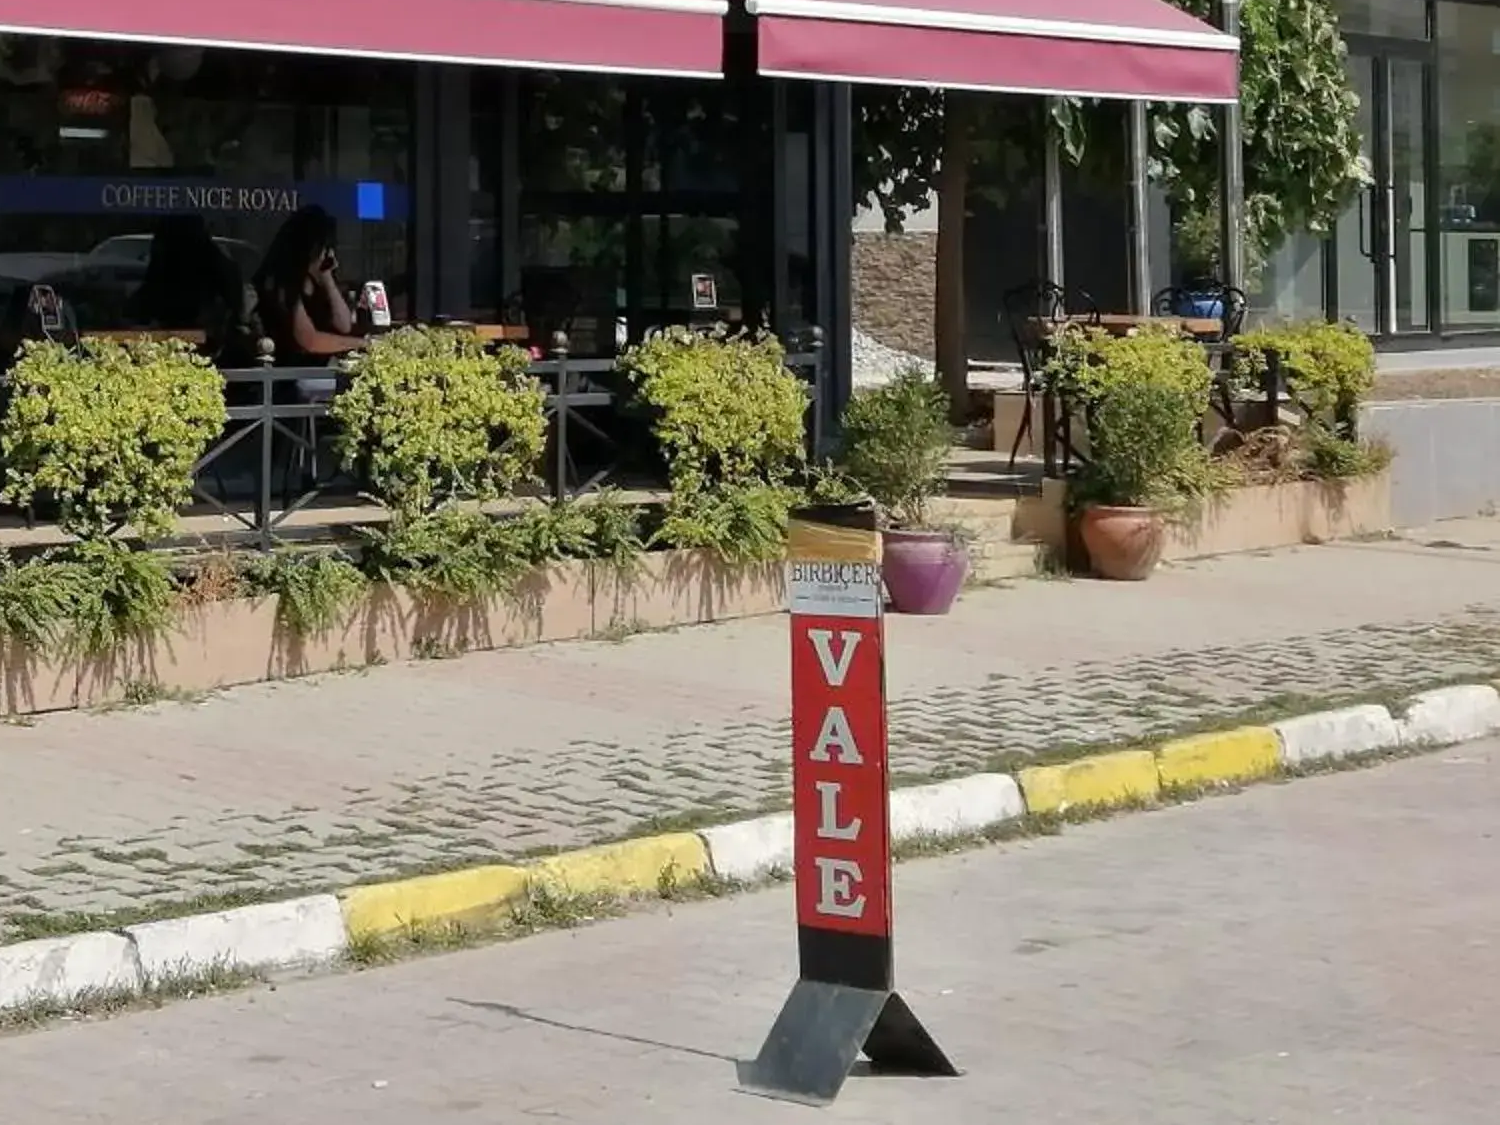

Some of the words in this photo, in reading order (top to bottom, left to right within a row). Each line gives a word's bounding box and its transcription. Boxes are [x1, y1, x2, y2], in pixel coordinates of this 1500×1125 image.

[101, 183, 180, 210] COFFEE
[186, 185, 234, 210] NICE
[807, 628, 866, 919] VALE
